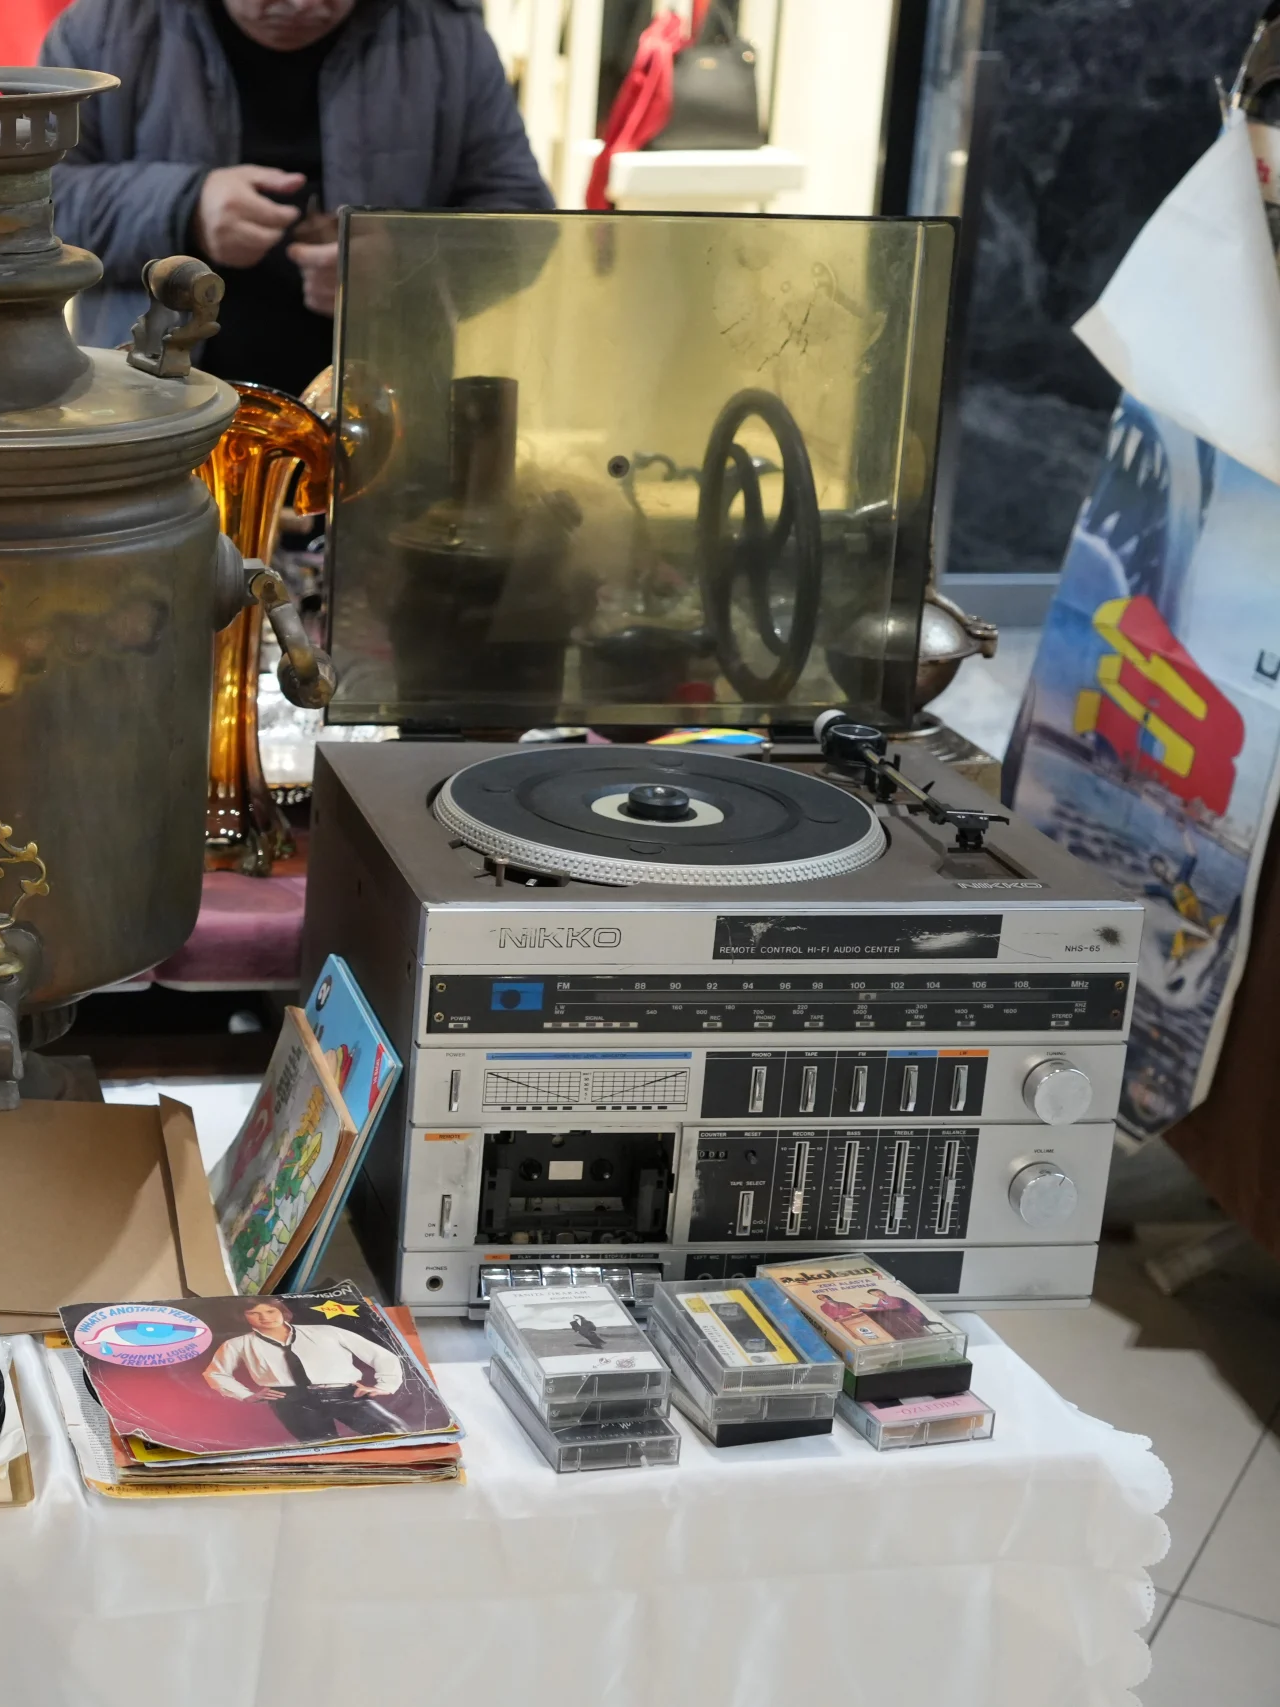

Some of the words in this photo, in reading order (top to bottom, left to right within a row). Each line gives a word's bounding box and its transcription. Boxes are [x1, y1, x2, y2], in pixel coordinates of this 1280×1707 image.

[499, 927, 622, 948] NIKKO
[719, 946, 756, 954] REMOTE
[760, 946, 803, 954] CONTROL
[864, 945, 900, 953] CENTER
[556, 982, 570, 990] FM
[634, 982, 646, 990] 88
[670, 982, 681, 990] 90
[706, 982, 718, 990] 92
[742, 982, 754, 990] 94
[779, 982, 791, 990] 96
[812, 982, 824, 990] 98
[890, 981, 905, 989] 102
[926, 981, 941, 989] 104
[972, 981, 987, 989] 106
[1014, 981, 1029, 989] 108
[1071, 981, 1089, 989] MHz
[282, 1285, 353, 1299] EUROVISION
[77, 1311, 108, 1333] WHAT'S
[109, 1306, 167, 1317] ANOTHER
[167, 1309, 198, 1324] YEAR
[112, 1352, 166, 1360] JOHNNY
[166, 1342, 198, 1358] LOGAN
[120, 1357, 175, 1366] IRELAND
[177, 1351, 200, 1363] 1980
